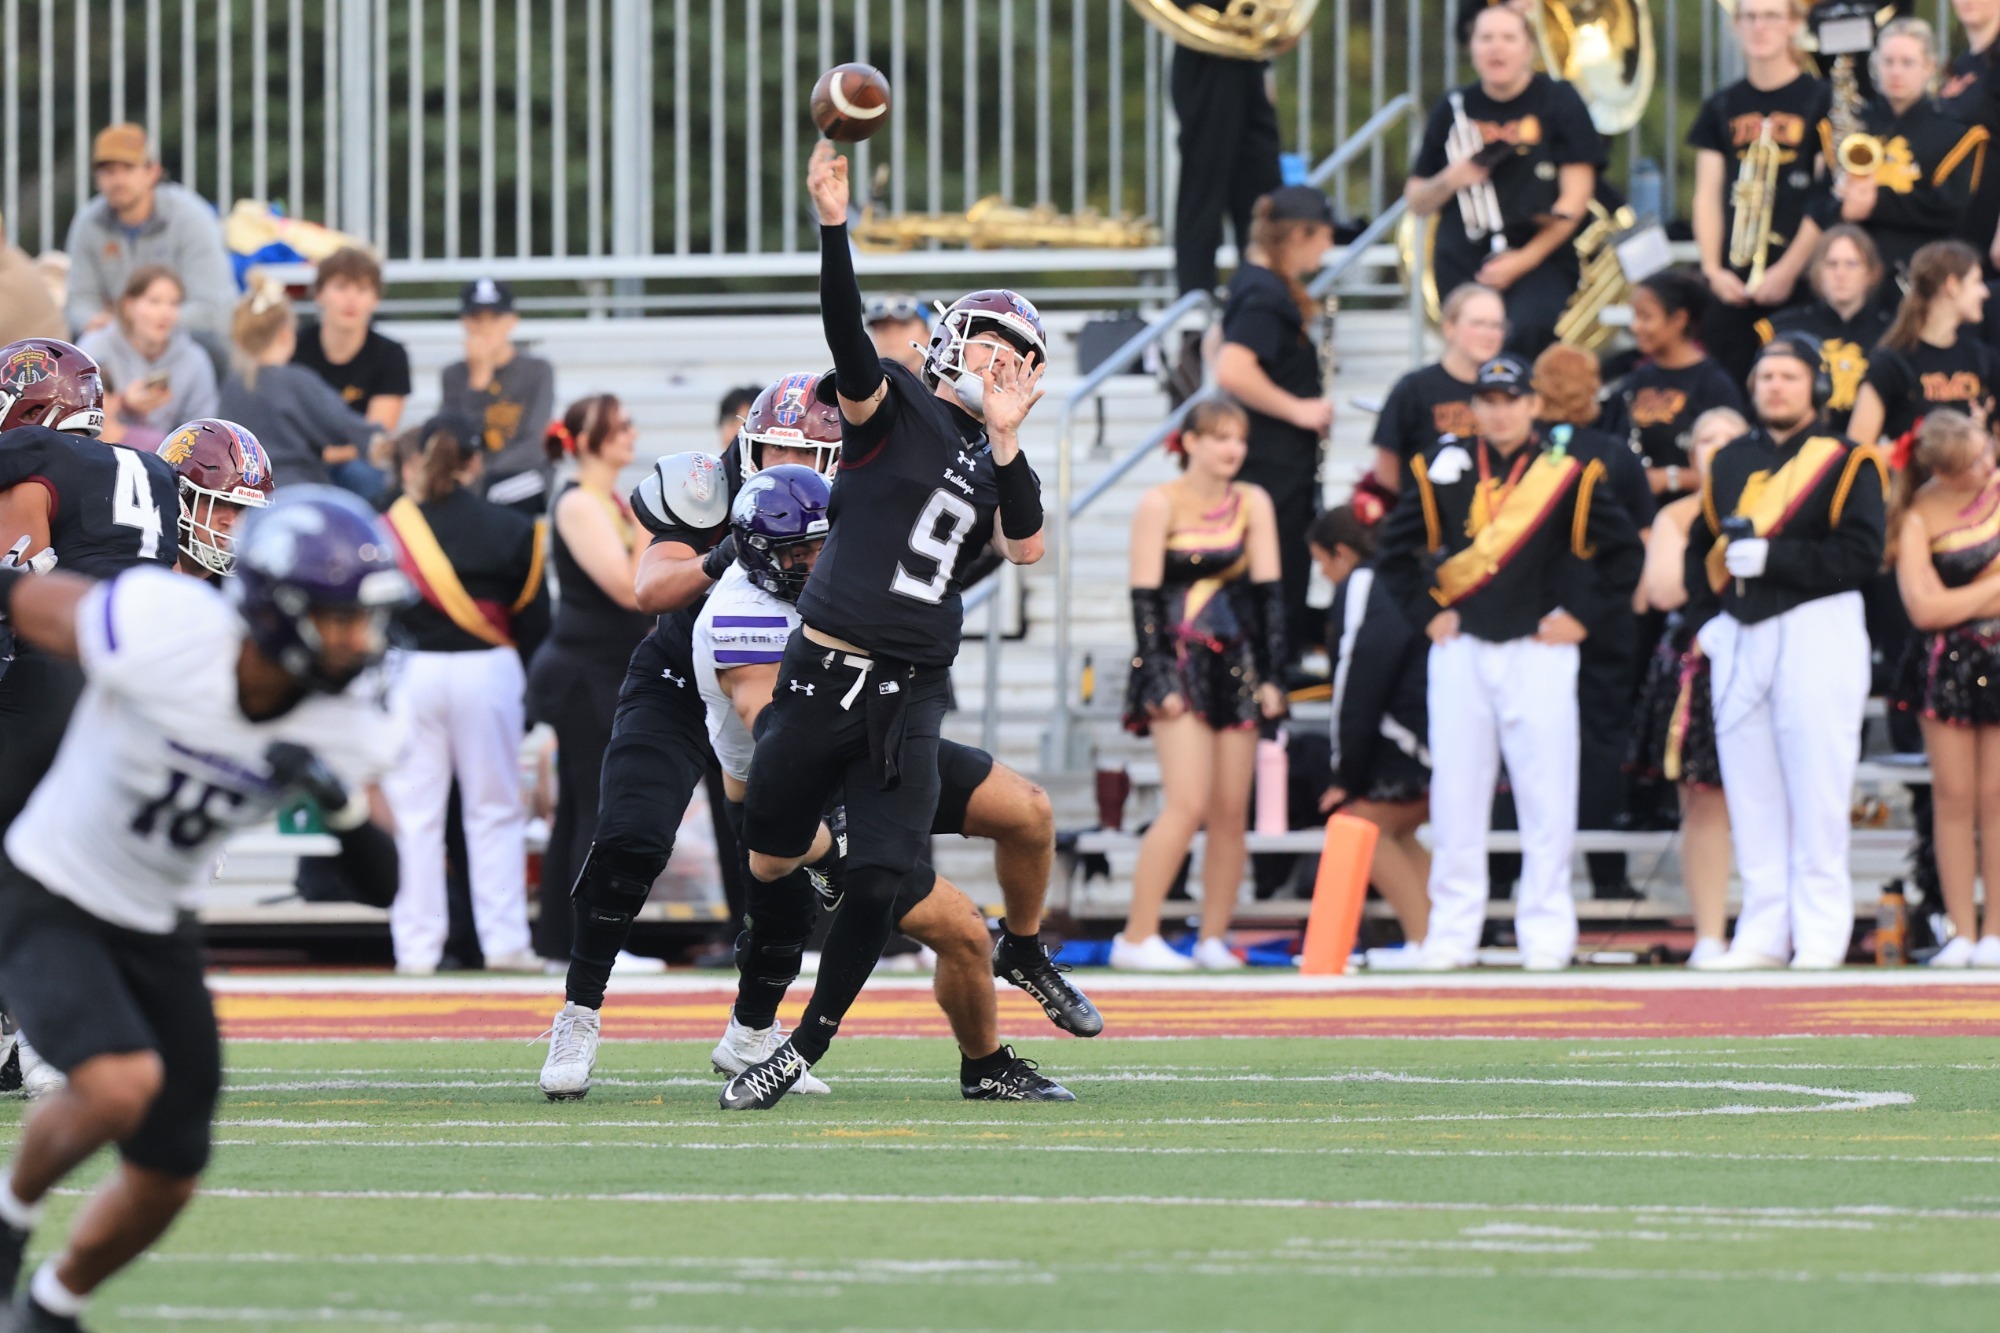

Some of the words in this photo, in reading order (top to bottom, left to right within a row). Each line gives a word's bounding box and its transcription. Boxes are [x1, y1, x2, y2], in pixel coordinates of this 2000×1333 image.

[769, 428, 799, 437] Riddell
[237, 488, 263, 499] Riddell
[942, 467, 975, 495] Bulldogs
[111, 446, 164, 560] 4
[888, 487, 978, 605] 9
[1010, 968, 1062, 1020] BATTLE
